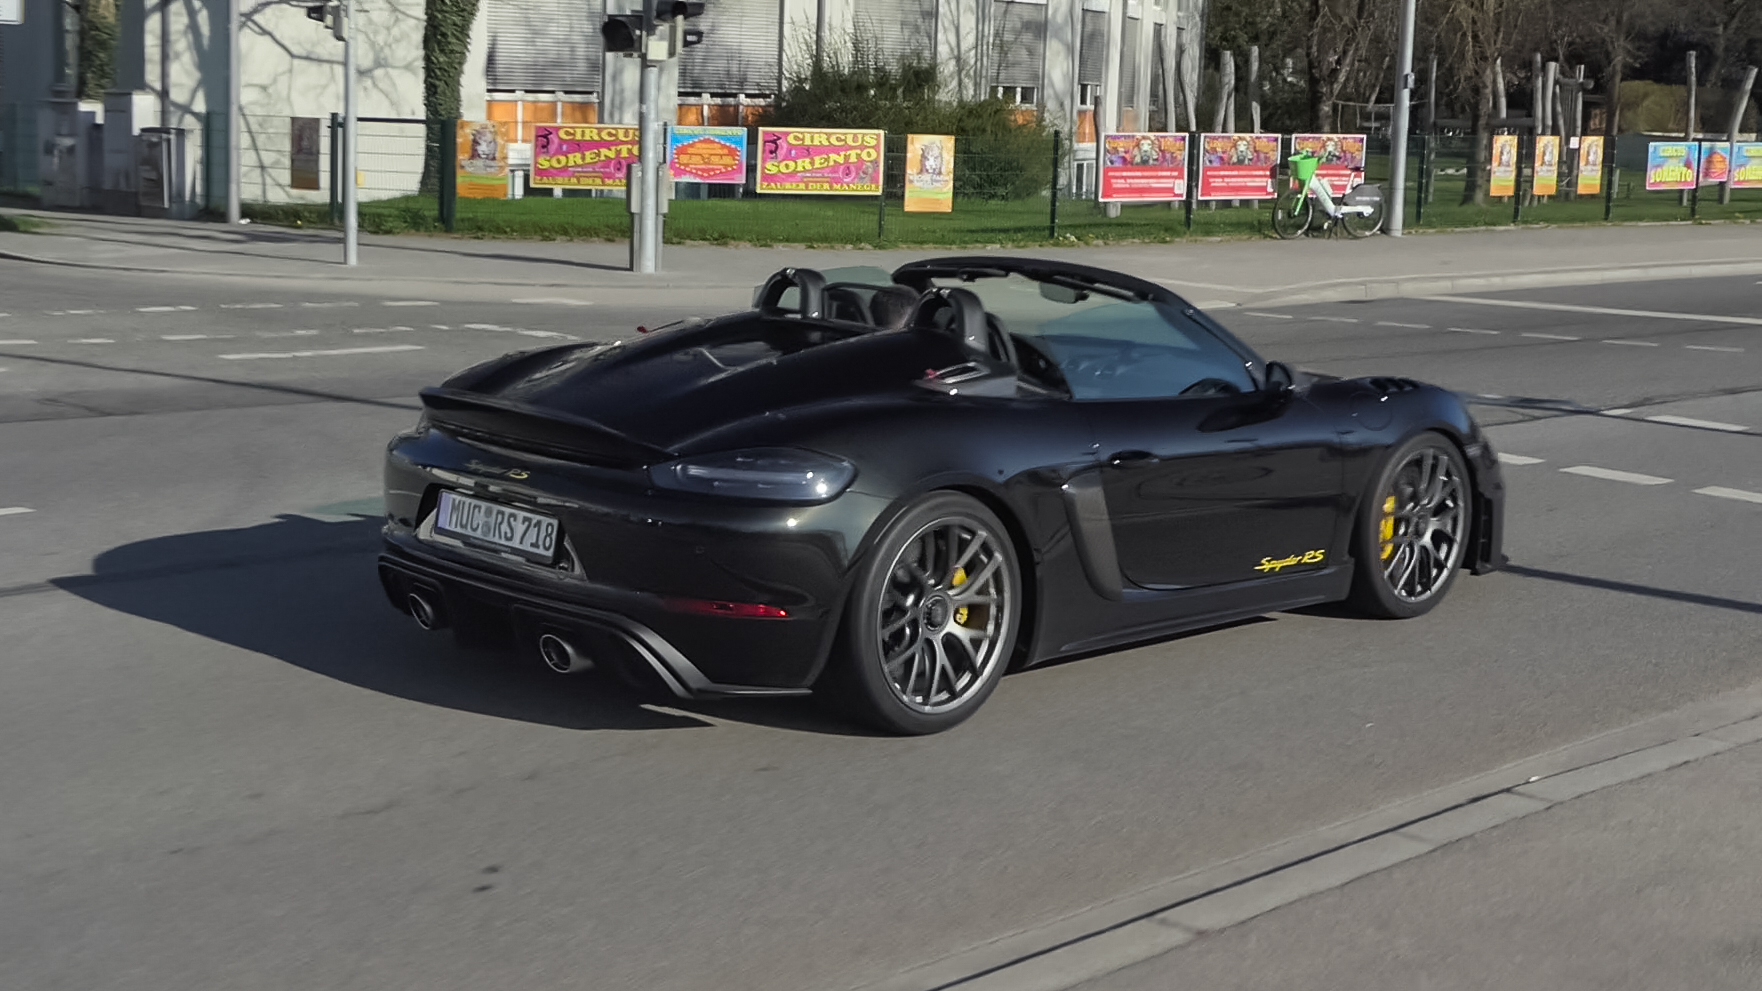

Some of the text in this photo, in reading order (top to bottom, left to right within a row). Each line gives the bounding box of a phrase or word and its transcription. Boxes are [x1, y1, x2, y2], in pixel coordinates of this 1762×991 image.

[786, 132, 877, 147] CIRCUS
[764, 147, 878, 174] SORENTO
[449, 498, 555, 551] MUC RS 718
[1301, 549, 1325, 563] RS
